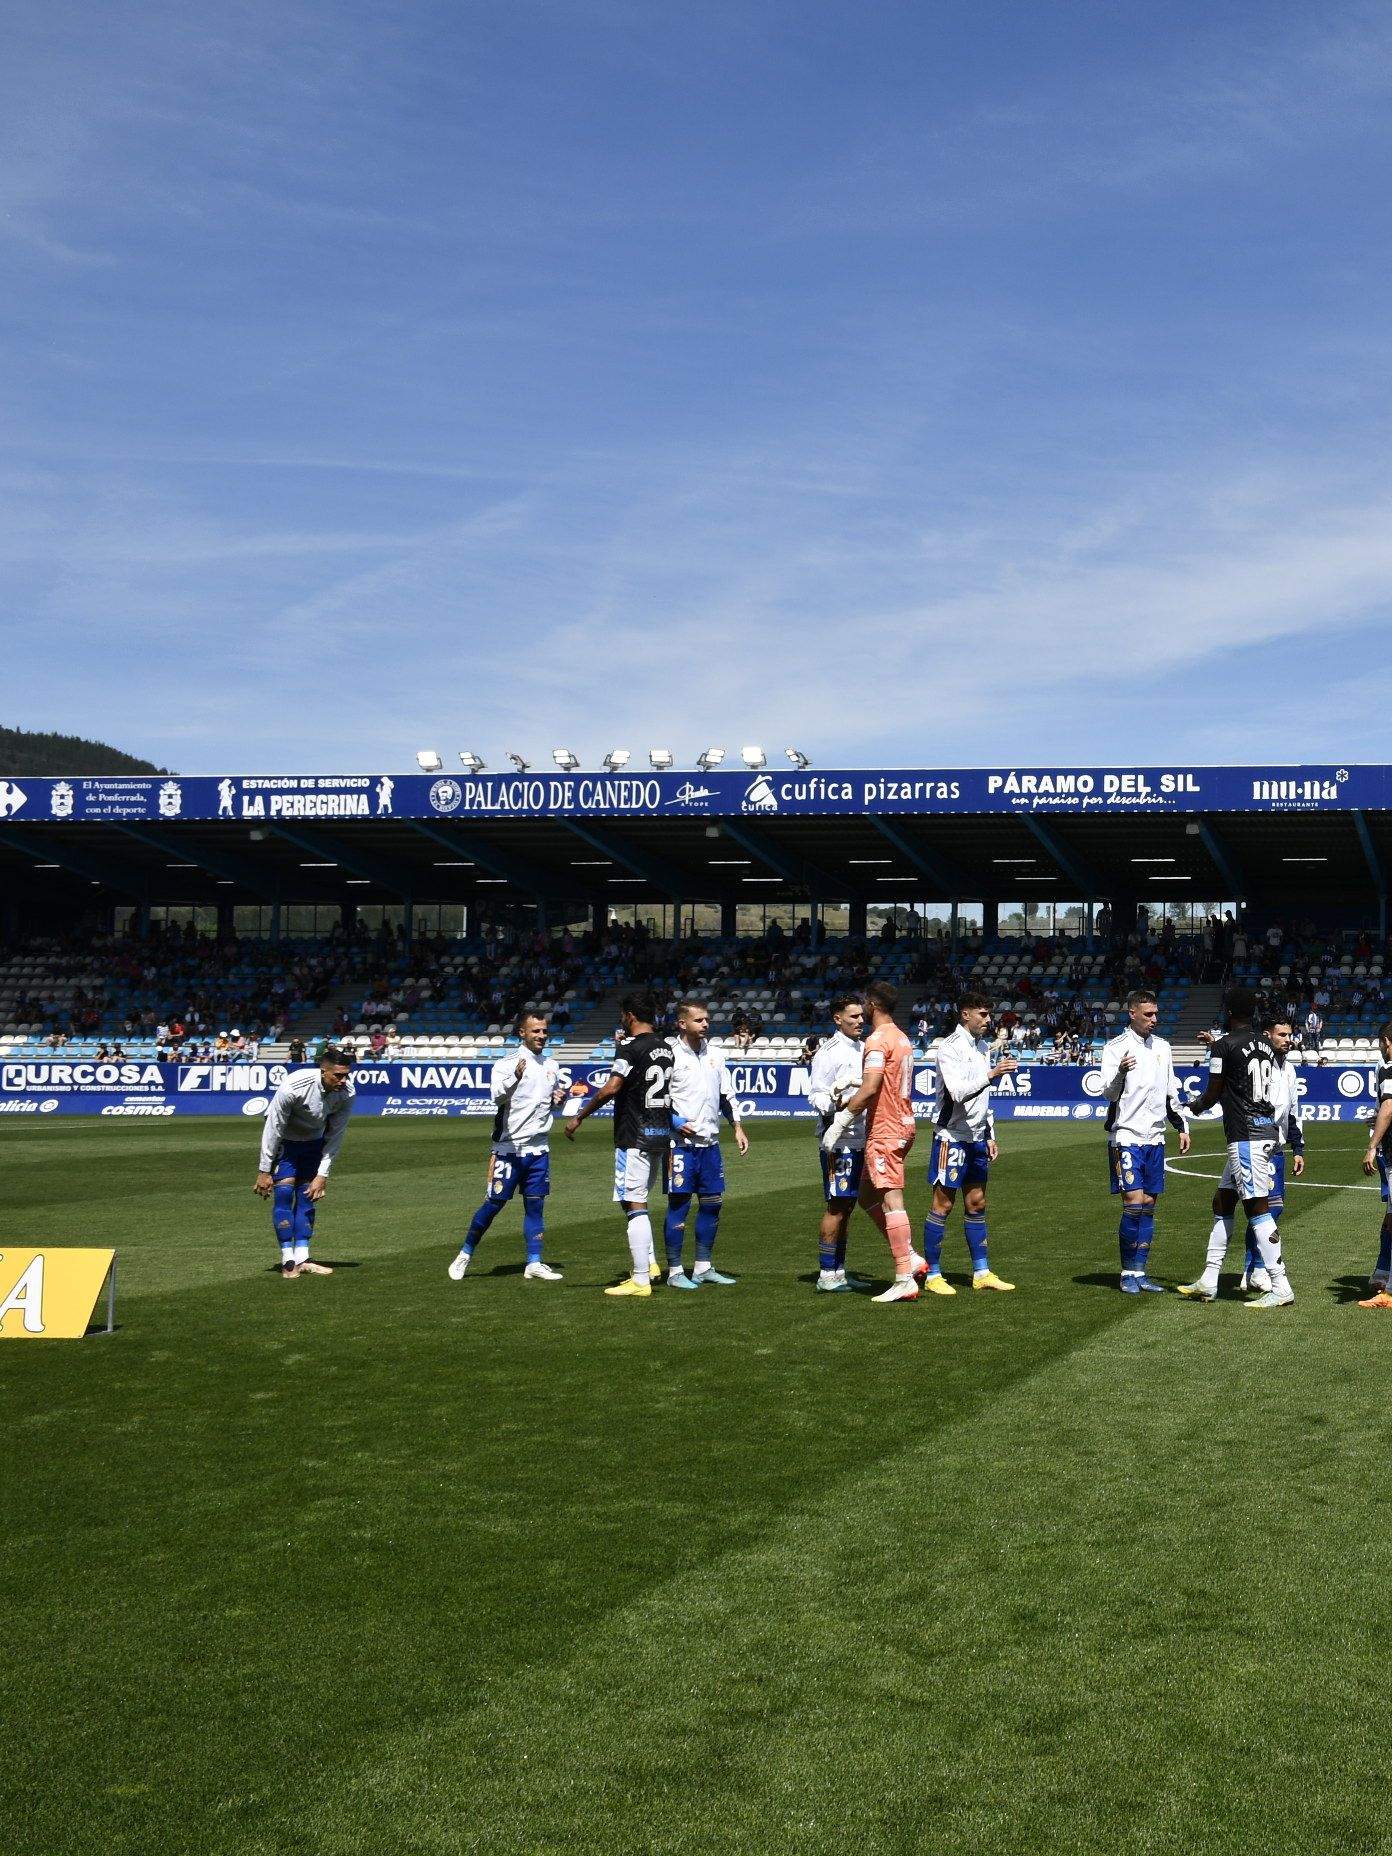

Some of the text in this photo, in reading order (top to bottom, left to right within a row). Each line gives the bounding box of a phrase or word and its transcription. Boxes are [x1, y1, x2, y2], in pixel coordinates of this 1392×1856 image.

[93, 782, 152, 791] Ayuntamiento
[243, 777, 370, 788] ESTACIÓN DE SERVICIO
[781, 777, 960, 804] cufica pizarras
[988, 772, 1200, 793] PÁRAMO DEL SIL
[464, 782, 544, 810] PALACIO
[549, 781, 574, 809] DE
[579, 780, 660, 808] CANEDO
[113, 806, 147, 815] deporte
[242, 794, 370, 816] LA PEREGRINA
[1248, 1058, 1272, 1102] 18
[101, 1105, 175, 1115] cosmos
[1014, 1106, 1069, 1116] MADERAS
[494, 1160, 512, 1179] 21
[673, 1155, 684, 1173] 5
[1122, 1152, 1132, 1170] 3
